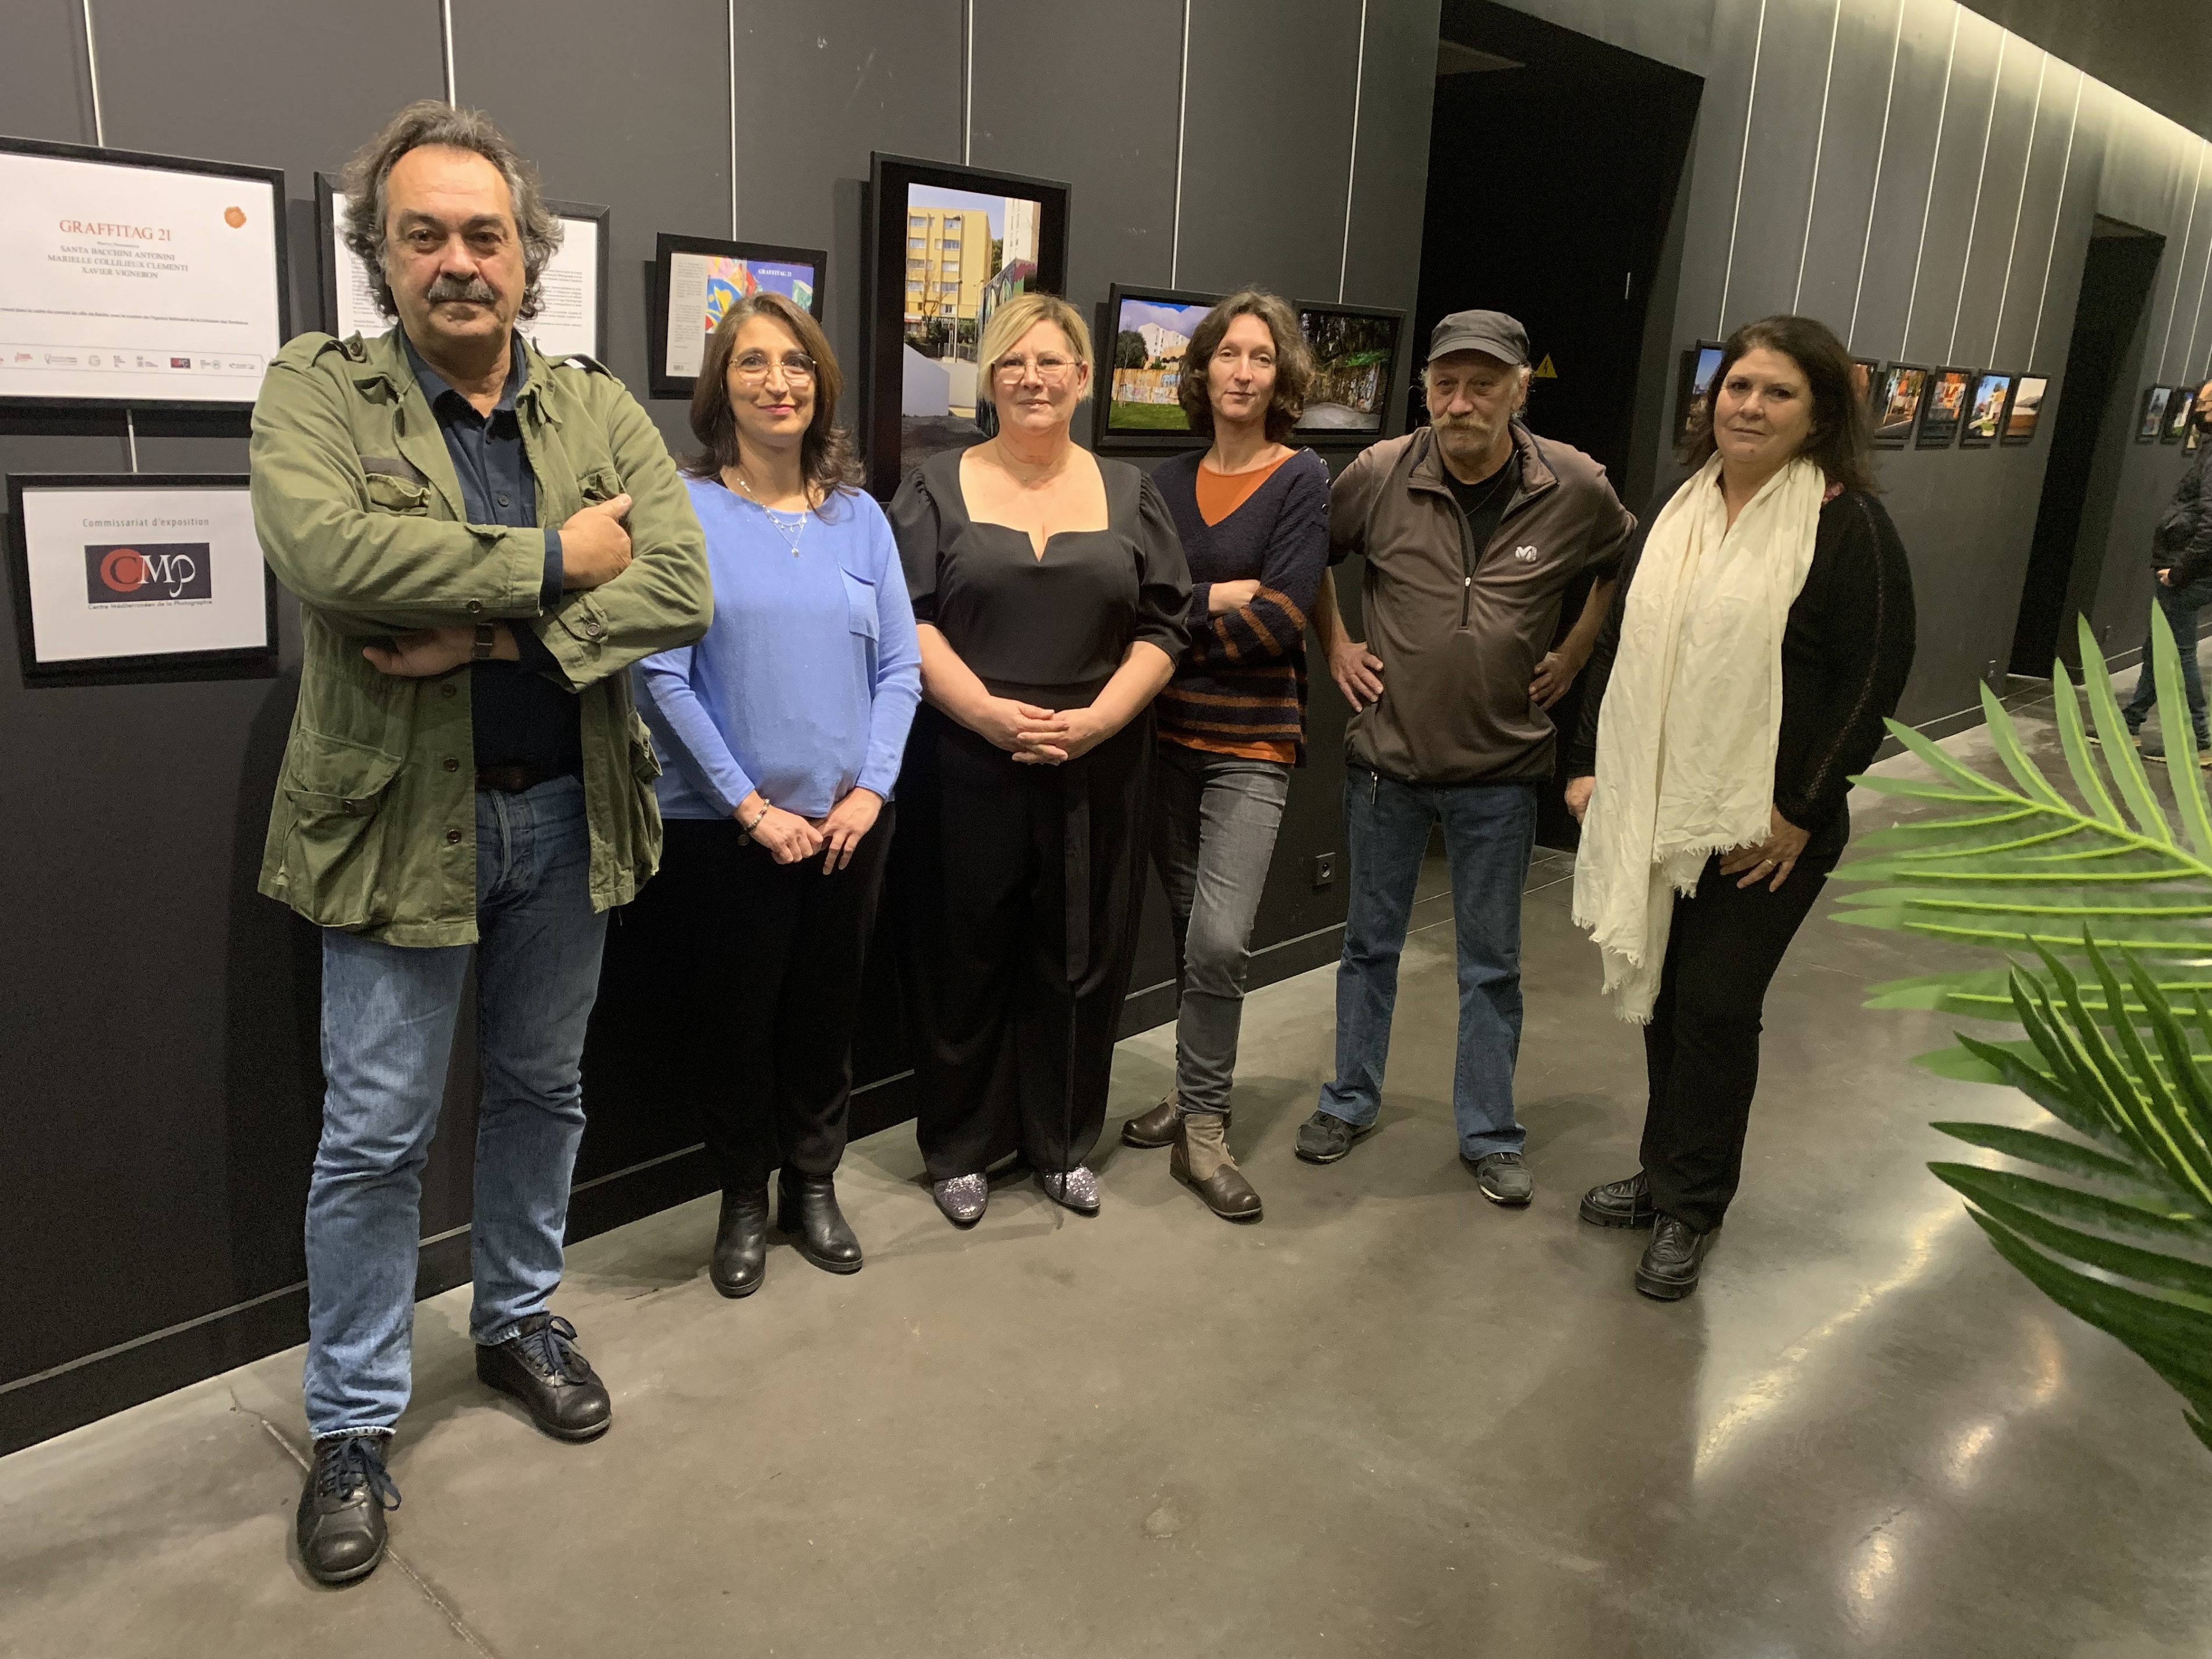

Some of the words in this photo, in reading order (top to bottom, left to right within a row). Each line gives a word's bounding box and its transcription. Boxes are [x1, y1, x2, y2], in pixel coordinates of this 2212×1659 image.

[59, 219, 153, 240] GRAFFITAG
[158, 228, 172, 241] 21
[60, 245, 88, 254] SANTA
[91, 247, 132, 257] BACCHINI
[135, 251, 175, 261] ANTONINI
[48, 254, 92, 264] MARIELLE
[147, 262, 189, 272] CLEMENTI
[81, 267, 113, 276] XAVIER
[116, 269, 158, 279] VIGNERON
[758, 268, 786, 276] GRAFFITAG
[83, 518, 148, 527] Commissariat
[152, 517, 209, 528] d'exposition
